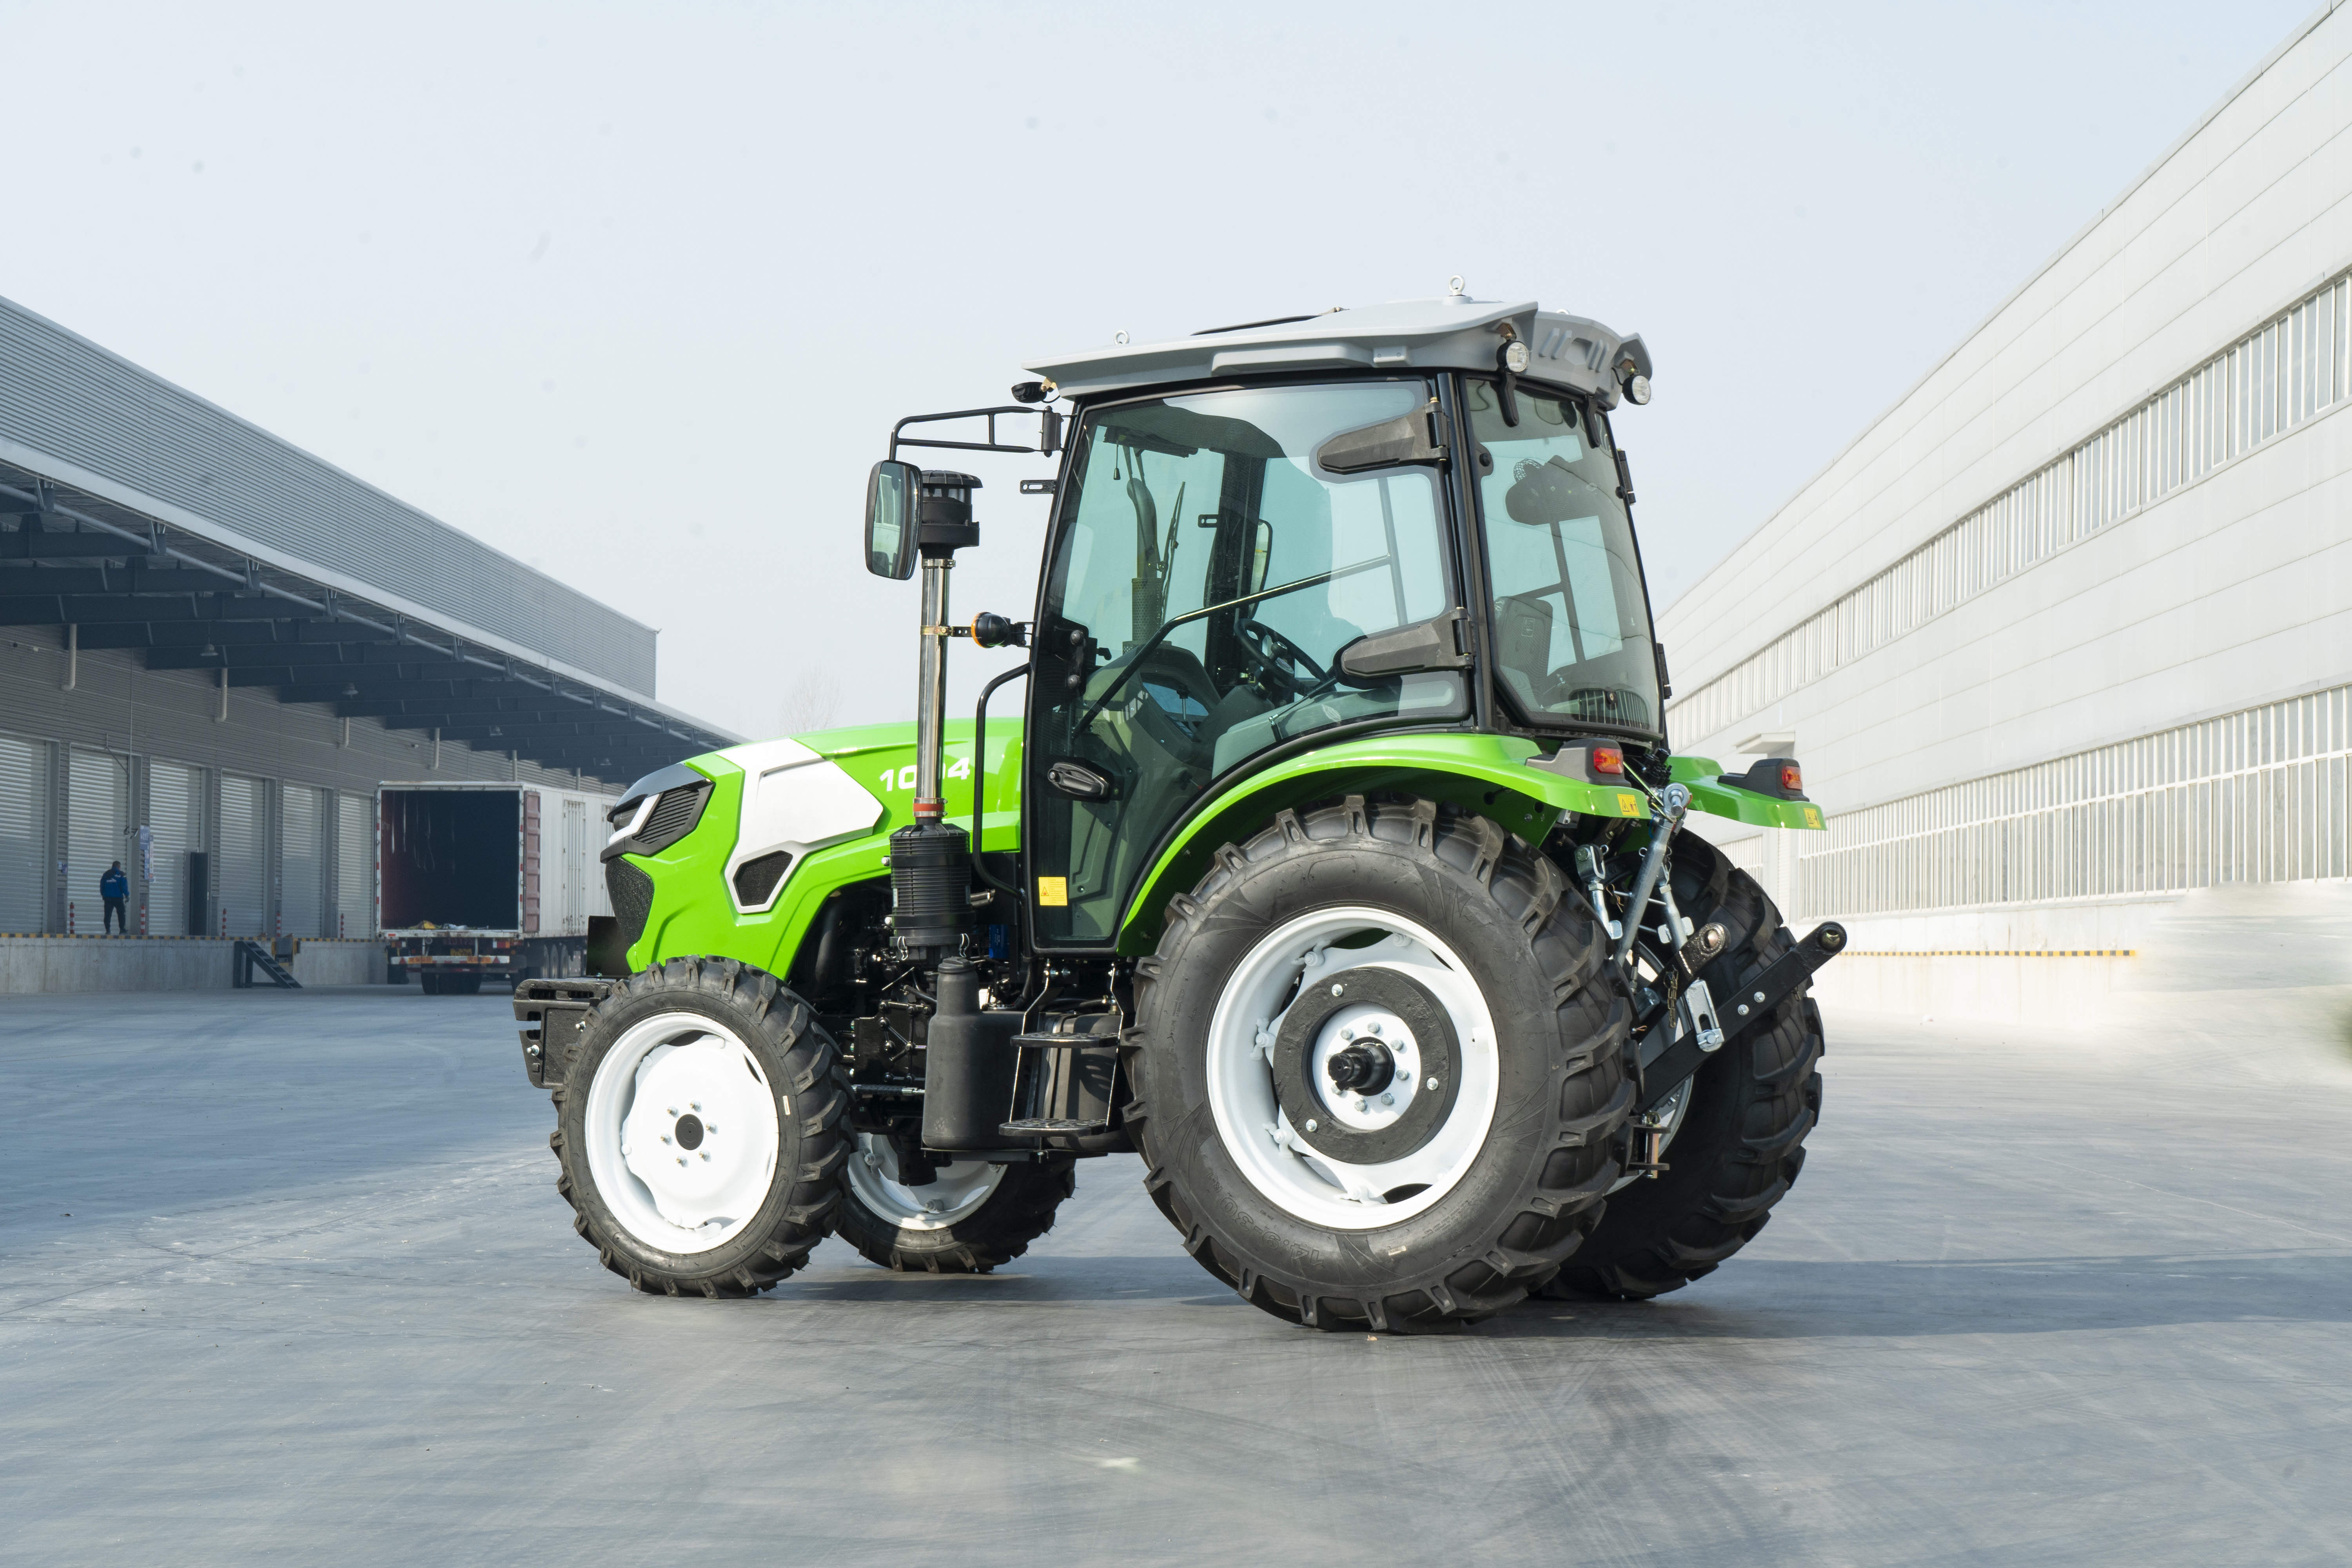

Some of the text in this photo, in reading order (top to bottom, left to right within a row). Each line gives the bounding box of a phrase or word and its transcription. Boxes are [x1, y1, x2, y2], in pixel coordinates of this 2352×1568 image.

[880, 757, 970, 791] 104
[1206, 1172, 1324, 1266] 14.9-30 R-1
